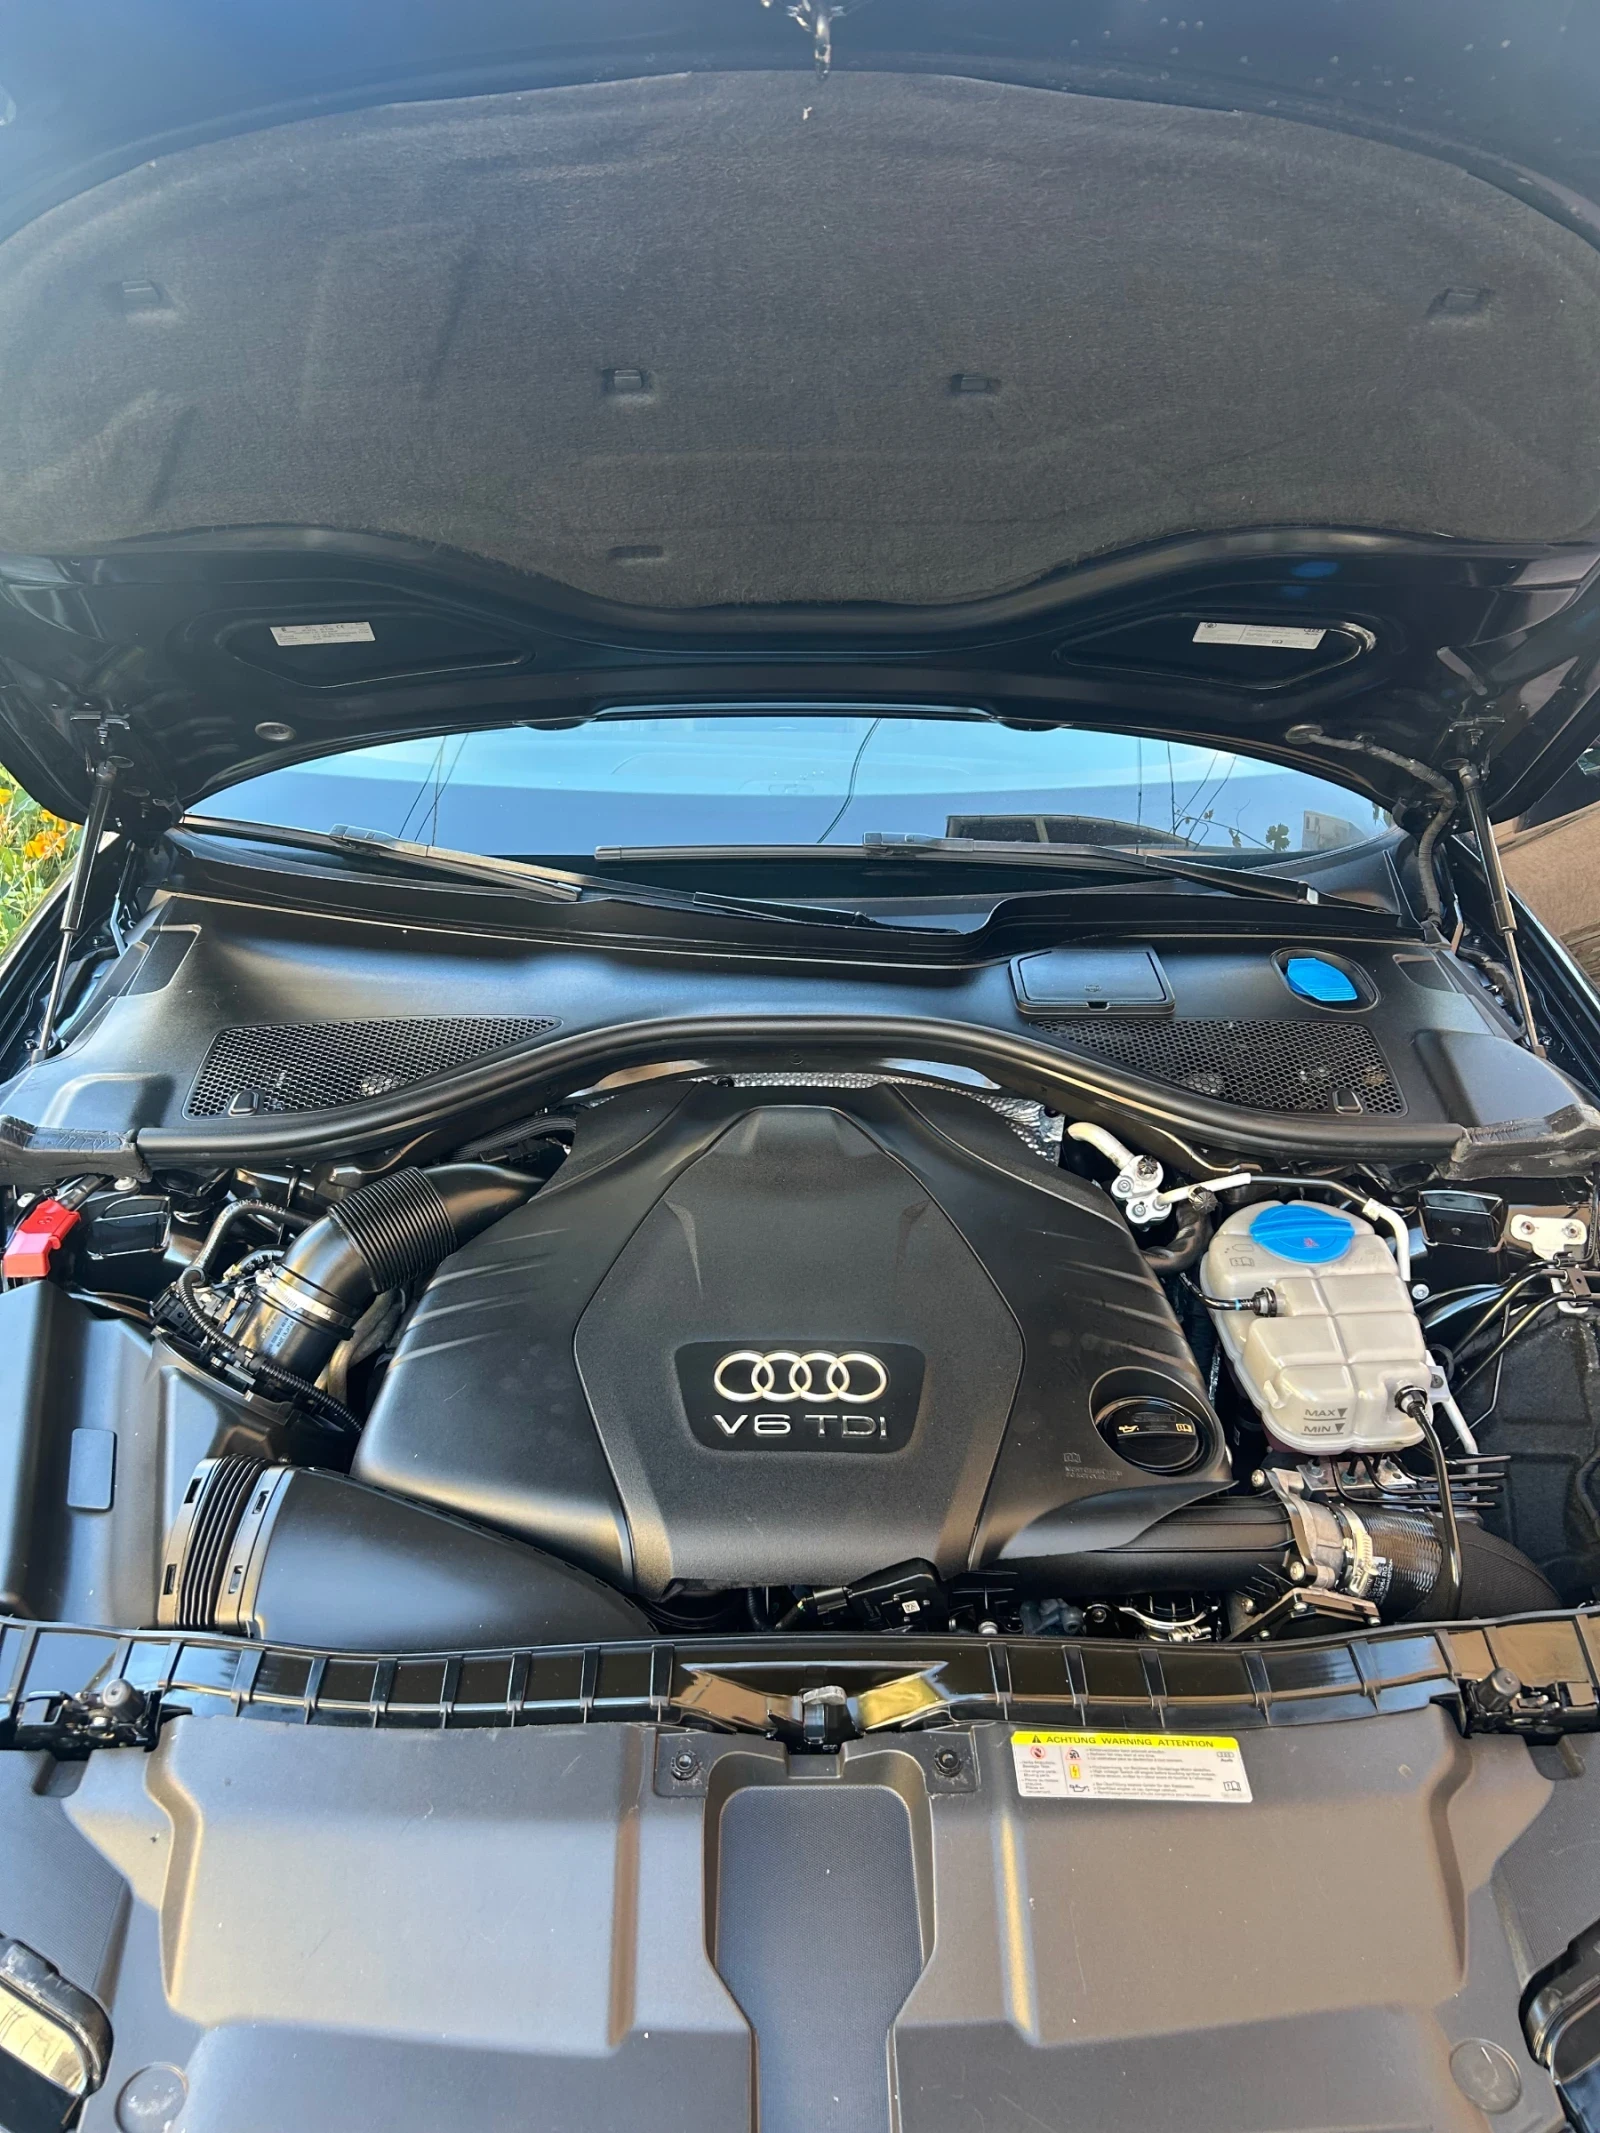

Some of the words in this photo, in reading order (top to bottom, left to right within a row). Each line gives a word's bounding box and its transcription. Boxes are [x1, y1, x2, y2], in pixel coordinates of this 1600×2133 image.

[1304, 1408, 1337, 1417] MAX
[712, 1413, 792, 1438] V6
[804, 1413, 888, 1440] TDI
[1303, 1424, 1331, 1433] MIN
[1046, 1735, 1096, 1745] ACHTUNG
[1101, 1737, 1152, 1746] WARNING
[1158, 1738, 1214, 1748] ATTENTION
